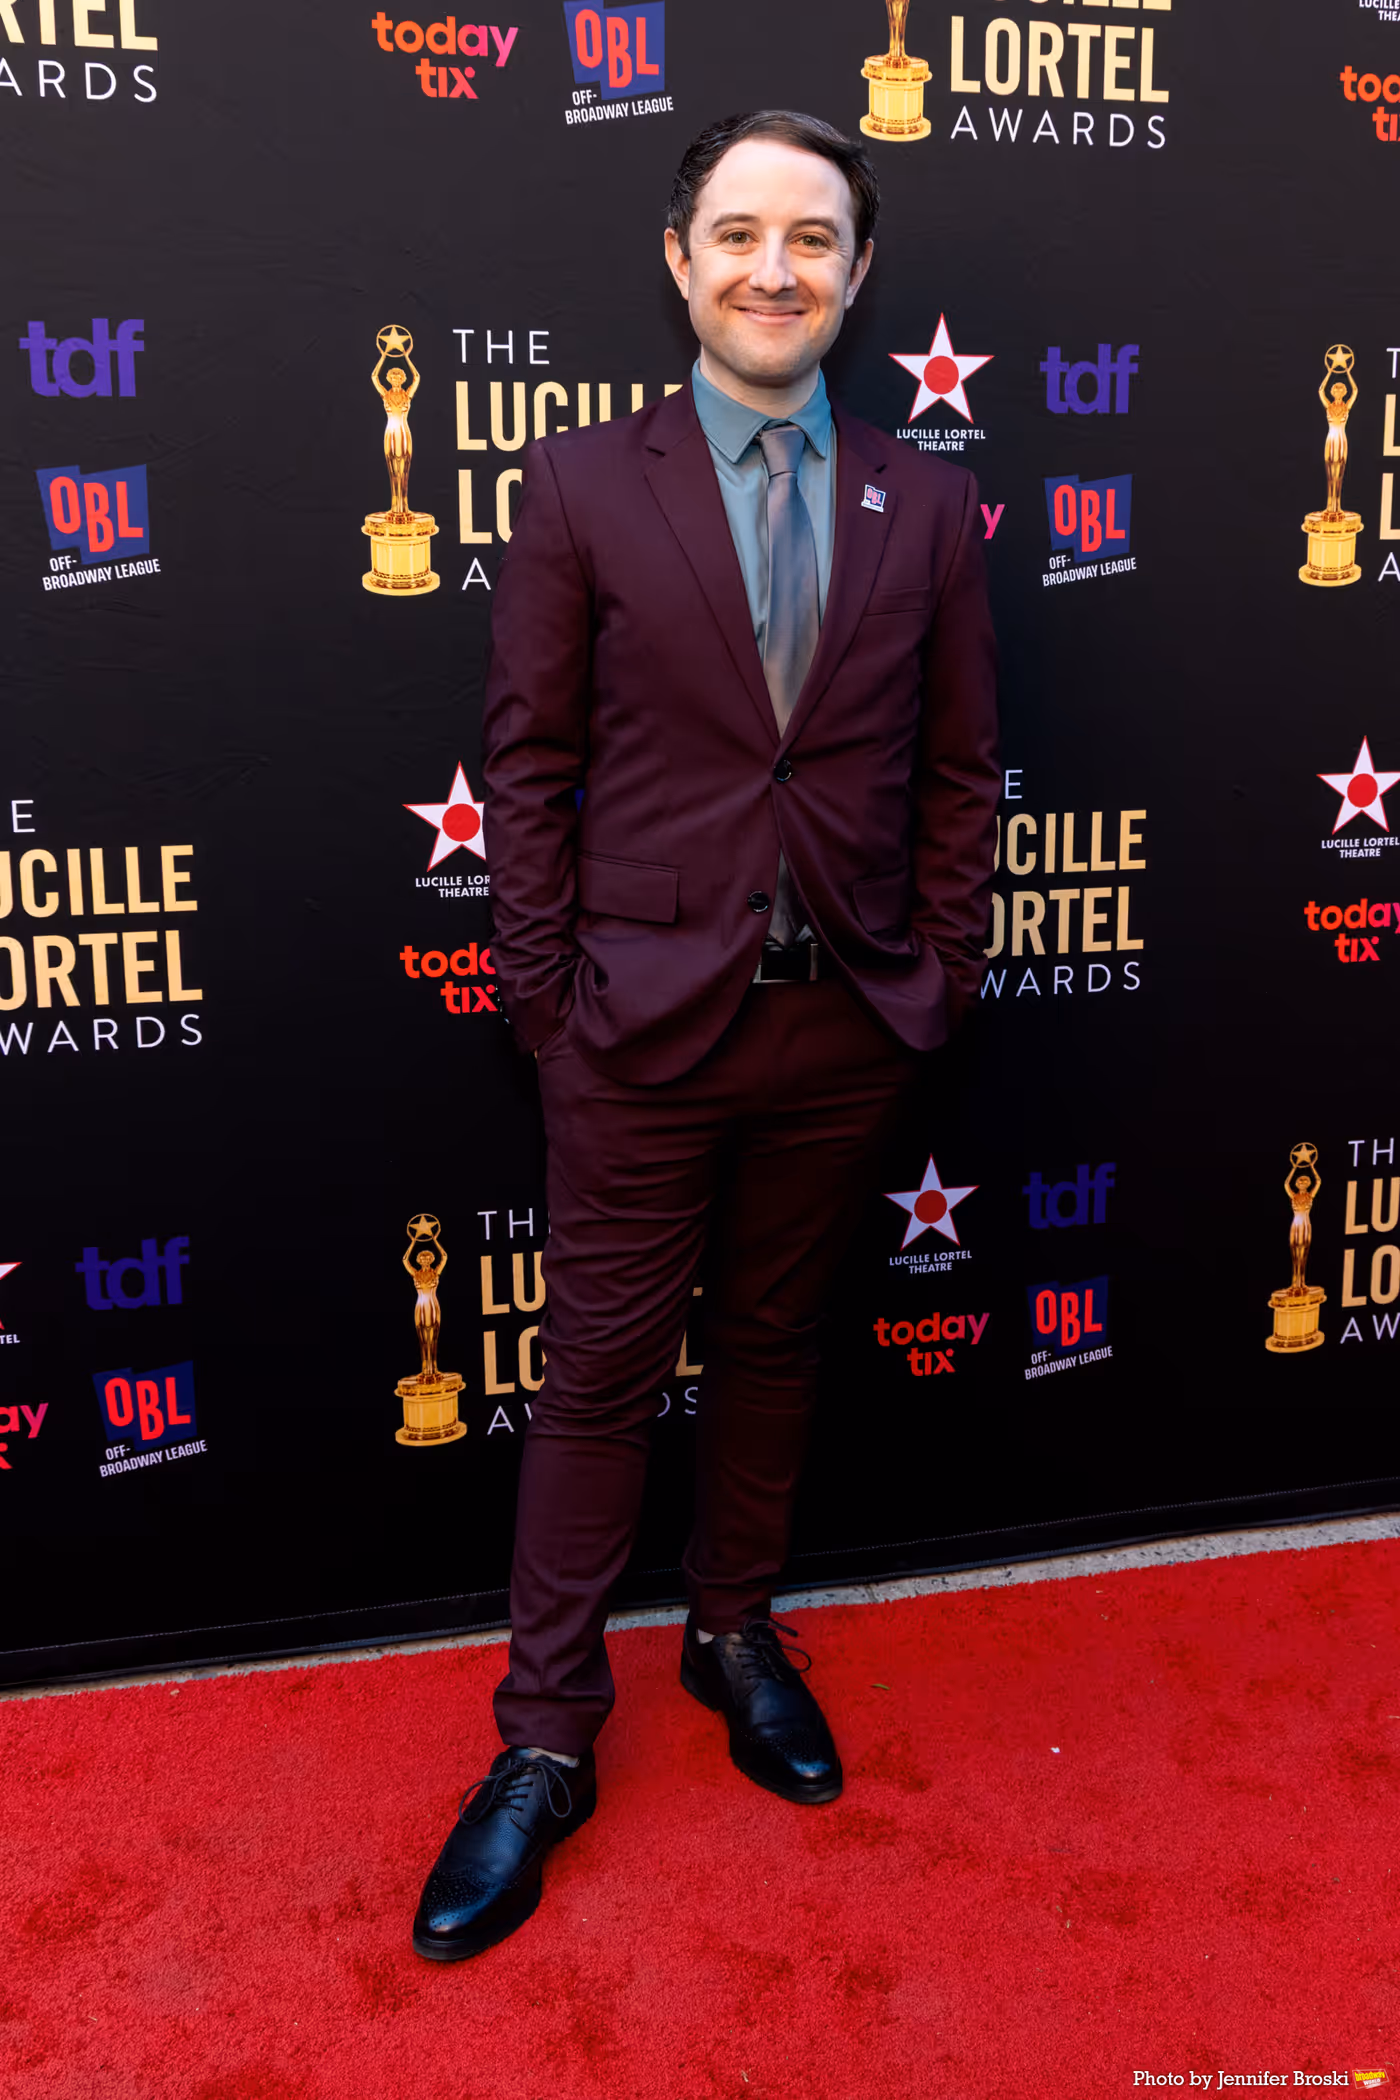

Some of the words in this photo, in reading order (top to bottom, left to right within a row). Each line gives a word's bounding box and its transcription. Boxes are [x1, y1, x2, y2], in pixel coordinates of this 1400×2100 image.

[371, 12, 519, 67] today
[575, 9, 660, 88] OBL
[950, 15, 1170, 103] LORTEL
[415, 58, 479, 99] tix
[565, 102, 631, 125] BROADWAY
[632, 96, 674, 116] LEAGUE
[572, 89, 598, 106] OFF-
[950, 105, 1167, 149] AWARDS
[19, 318, 145, 398] tdf
[452, 329, 550, 365] THE
[1040, 343, 1140, 415] tdf
[896, 429, 940, 440] LUCILLE
[944, 429, 986, 440] LORTEL
[917, 441, 965, 451] THEATRE
[50, 476, 144, 553] OBL
[1054, 484, 1126, 552] OBL
[42, 566, 113, 591] BROADWAY
[114, 558, 162, 579] LEAGUE
[49, 555, 77, 572] OFF-
[1042, 565, 1099, 587] BROADWAY
[1100, 557, 1137, 576] LEAGUE
[1049, 555, 1072, 569] OFF-
[1321, 838, 1360, 849] LUCILLE
[1363, 837, 1400, 847] LORTEL
[1339, 848, 1381, 858] THEATRE
[415, 876, 463, 888] LUCILLE
[438, 886, 490, 898] THEATRE
[1334, 933, 1381, 963] tix
[440, 981, 499, 1014] tix
[1022, 1162, 1117, 1229] tdf
[477, 1207, 551, 1240] TH
[75, 1236, 190, 1310] tdf
[889, 1253, 930, 1266] LUCILLE
[933, 1250, 972, 1263] LORTEL
[909, 1262, 953, 1275] THEATRE
[873, 1312, 990, 1347] today
[1036, 1289, 1102, 1347] OBL
[907, 1347, 956, 1377] tix
[1025, 1356, 1077, 1380] BROADWAY
[1078, 1346, 1113, 1365] LEAGUE
[1031, 1352, 1052, 1365] OFF-
[105, 1377, 191, 1441] OBL
[99, 1450, 163, 1478] BROADWAY
[164, 1439, 208, 1461] LEAGUE
[105, 1445, 131, 1460] OFF-
